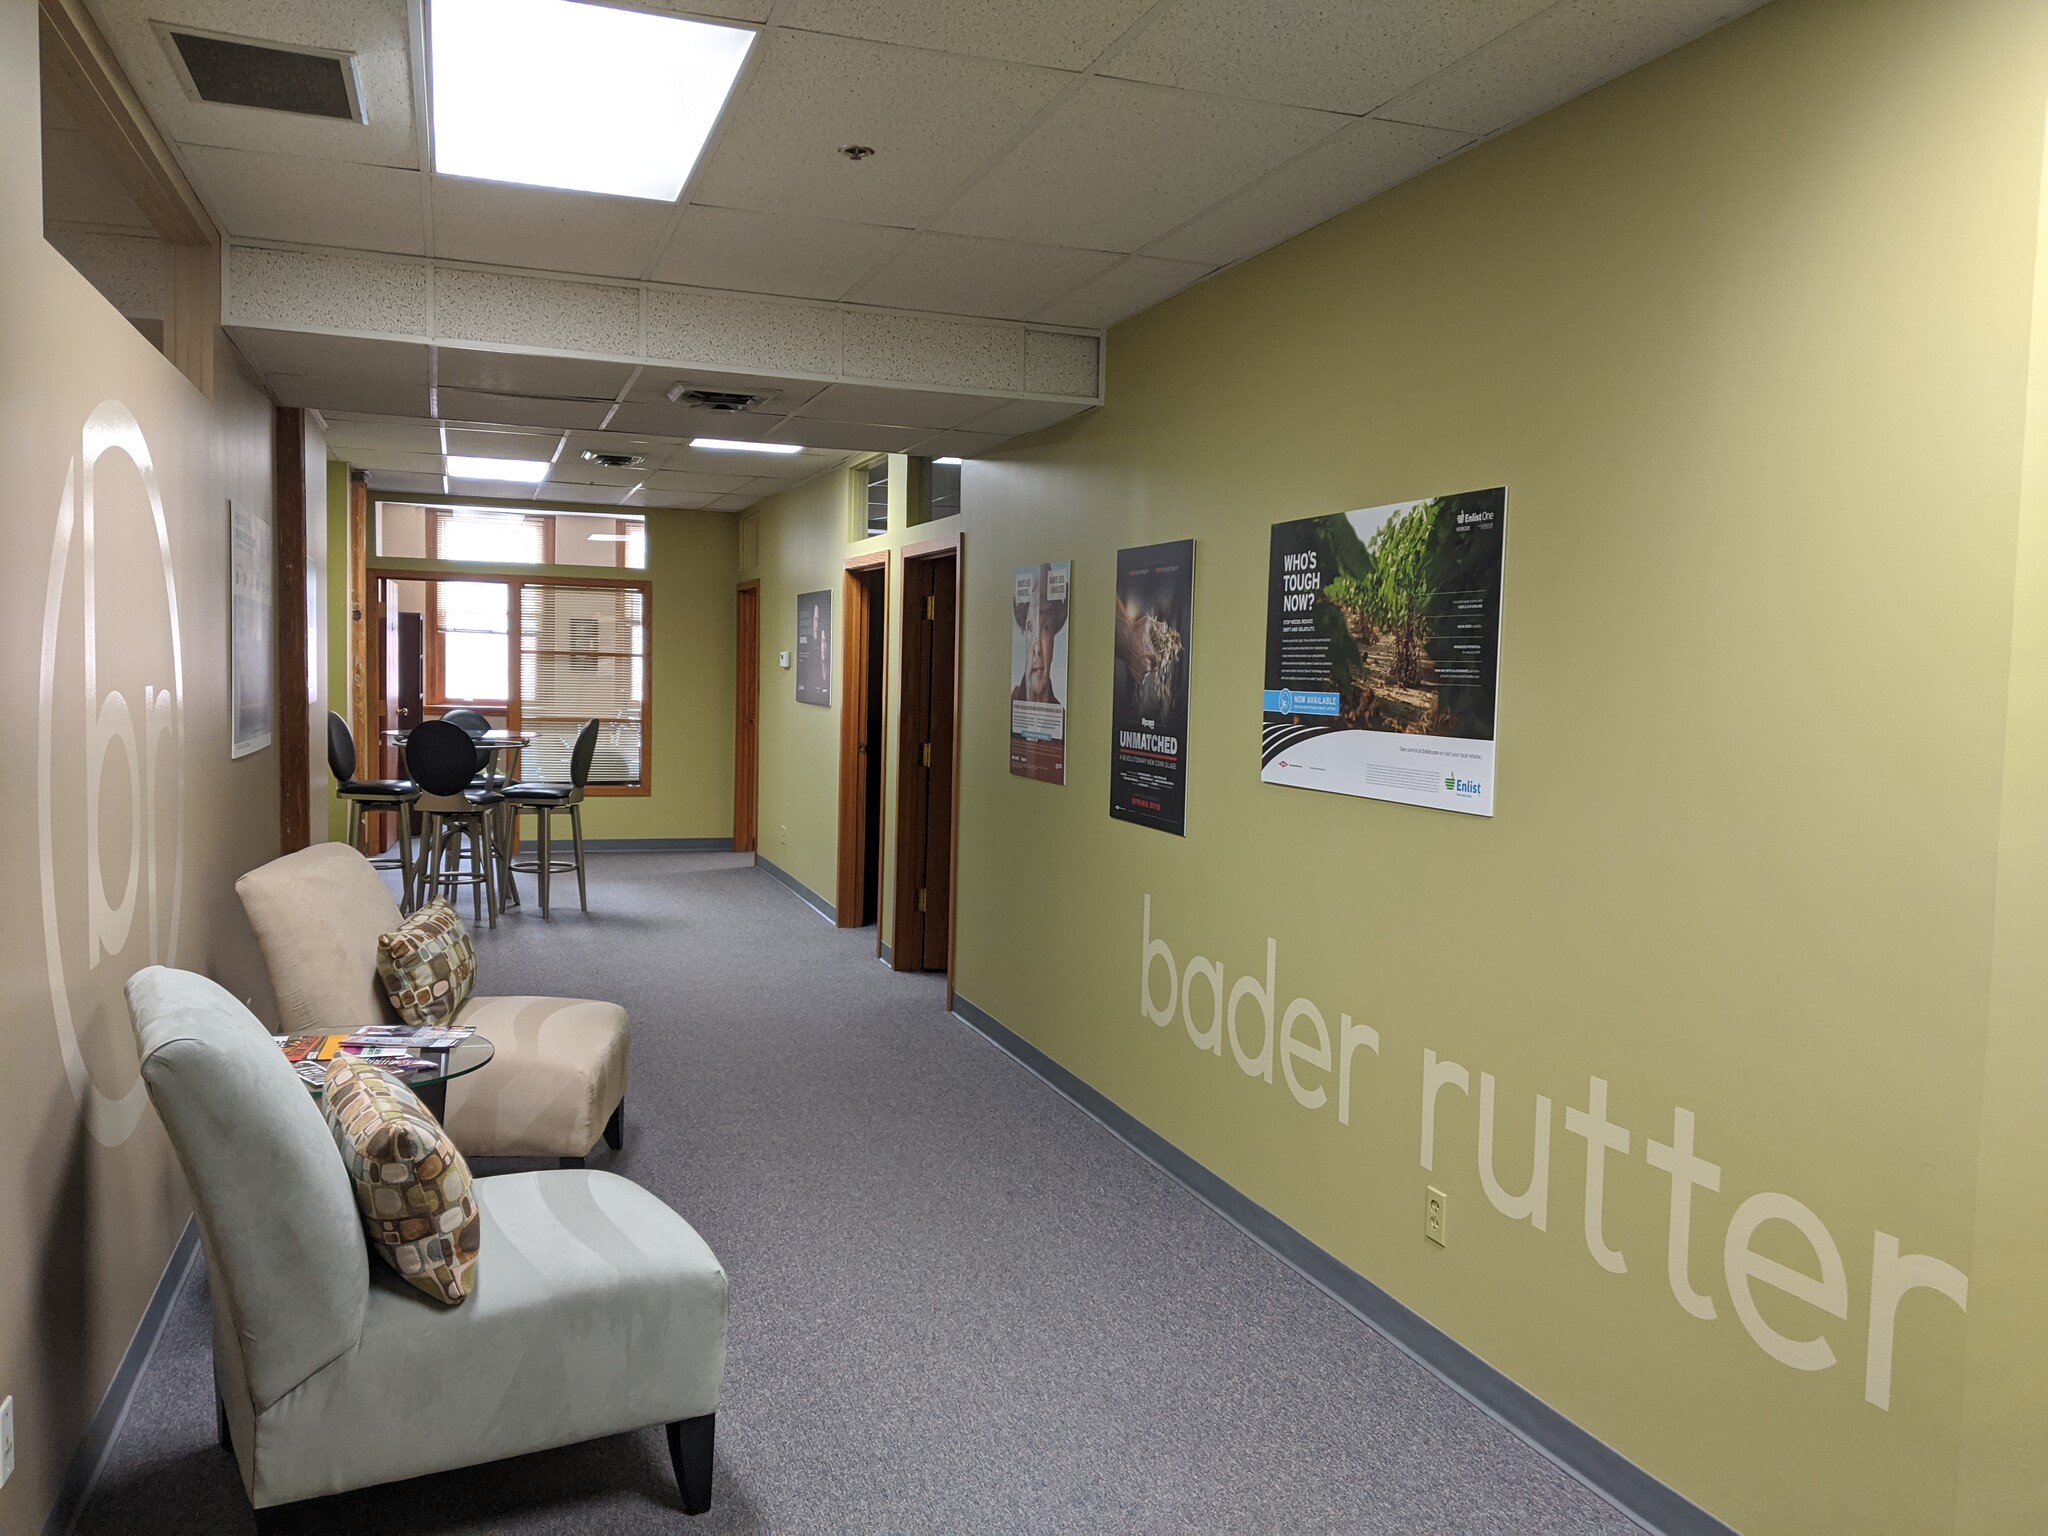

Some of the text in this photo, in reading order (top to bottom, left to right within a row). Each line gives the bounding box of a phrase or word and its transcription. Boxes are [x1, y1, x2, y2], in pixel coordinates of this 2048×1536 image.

[1465, 511, 1494, 523] Enlist One
[1284, 550, 1317, 572] WHO'S
[1283, 571, 1320, 592] TOUGH
[1283, 593, 1315, 612] NOW?
[1294, 696, 1336, 706] NOW AVAILABLE
[1120, 730, 1178, 755] UNMATCHED
[1456, 779, 1481, 794] Enlist
[1141, 893, 1969, 1413] bader rutter
